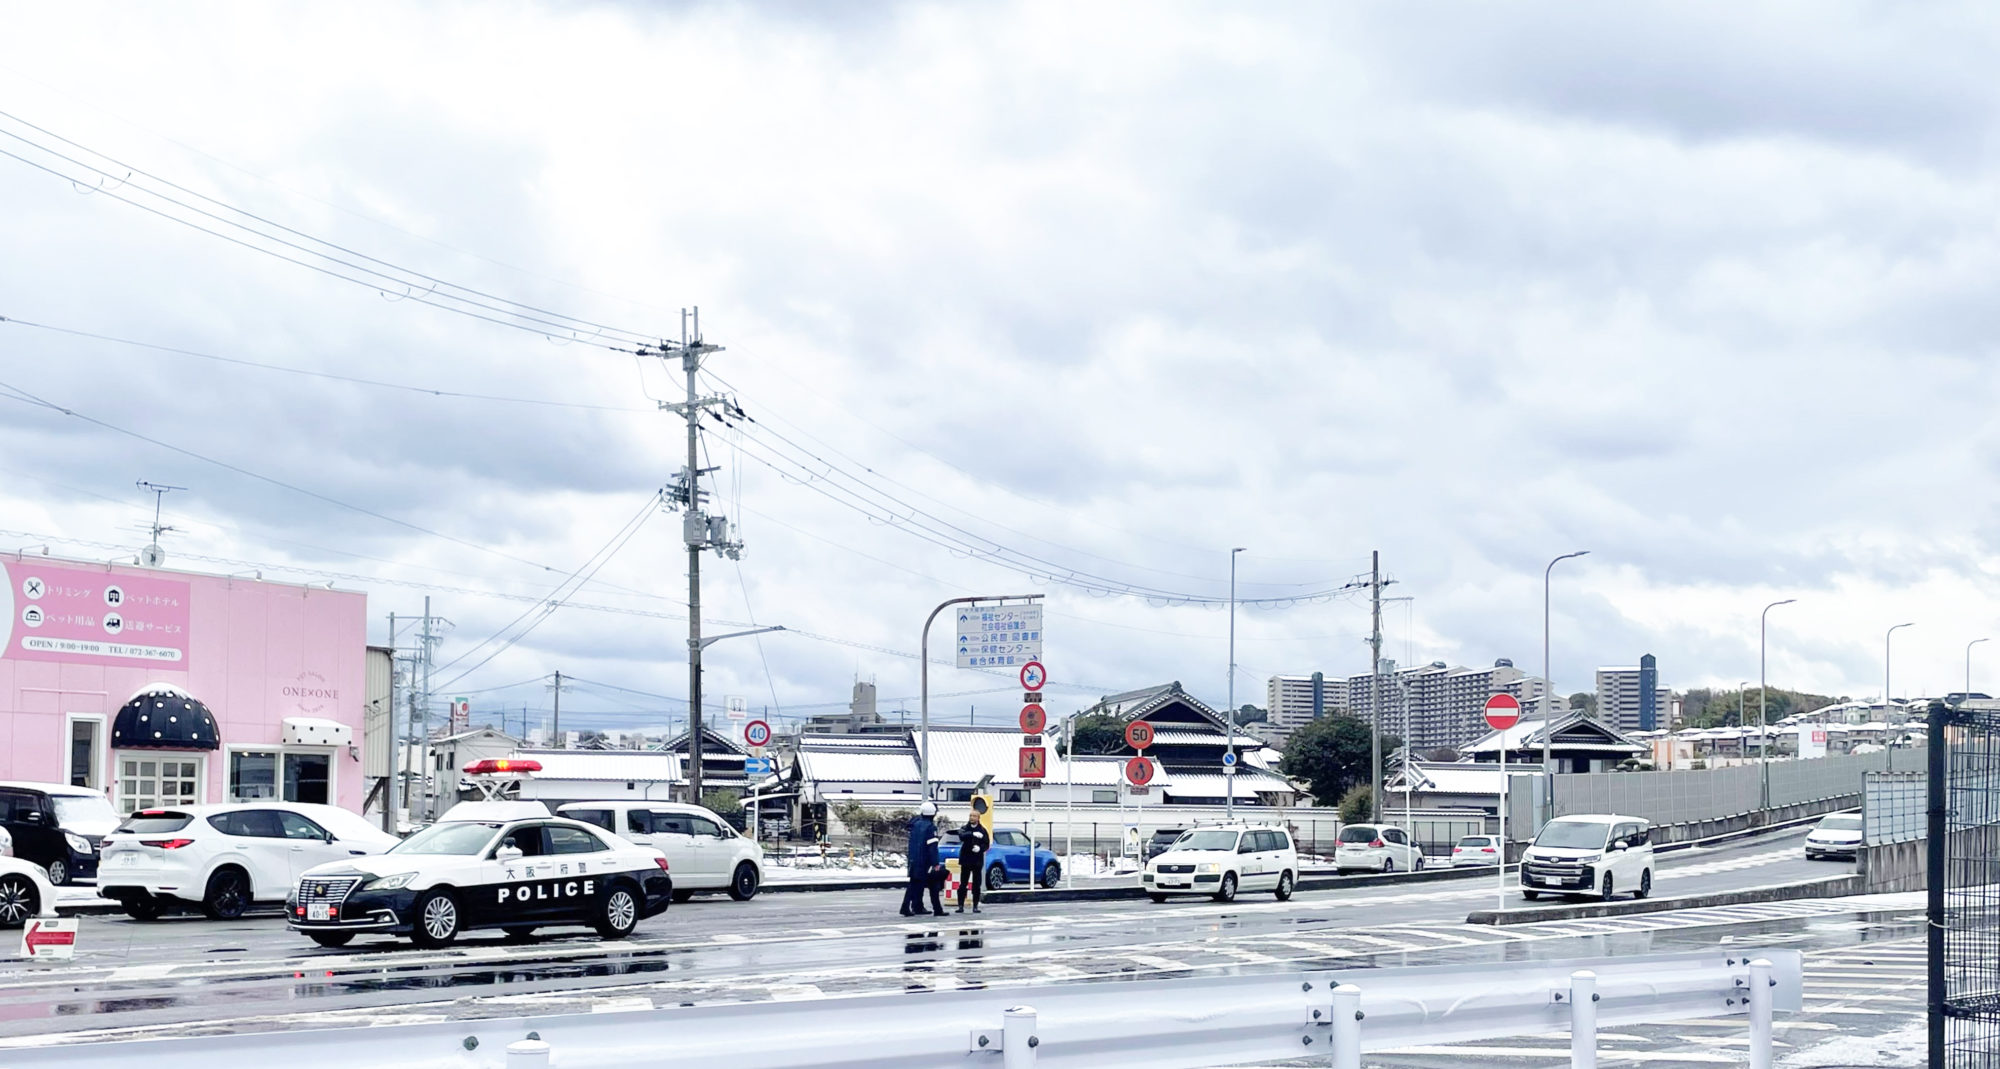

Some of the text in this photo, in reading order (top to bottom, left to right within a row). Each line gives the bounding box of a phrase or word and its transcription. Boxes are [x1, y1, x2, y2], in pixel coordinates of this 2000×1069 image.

[47, 585, 92, 598] トリミング
[126, 595, 179, 607] ペットホテル
[46, 614, 96, 627] ペット用品
[29, 639, 53, 648] OPEN
[108, 645, 123, 654] TEL
[750, 728, 765, 739] 40
[1132, 729, 1147, 741] 50
[498, 880, 595, 903] POLICE
